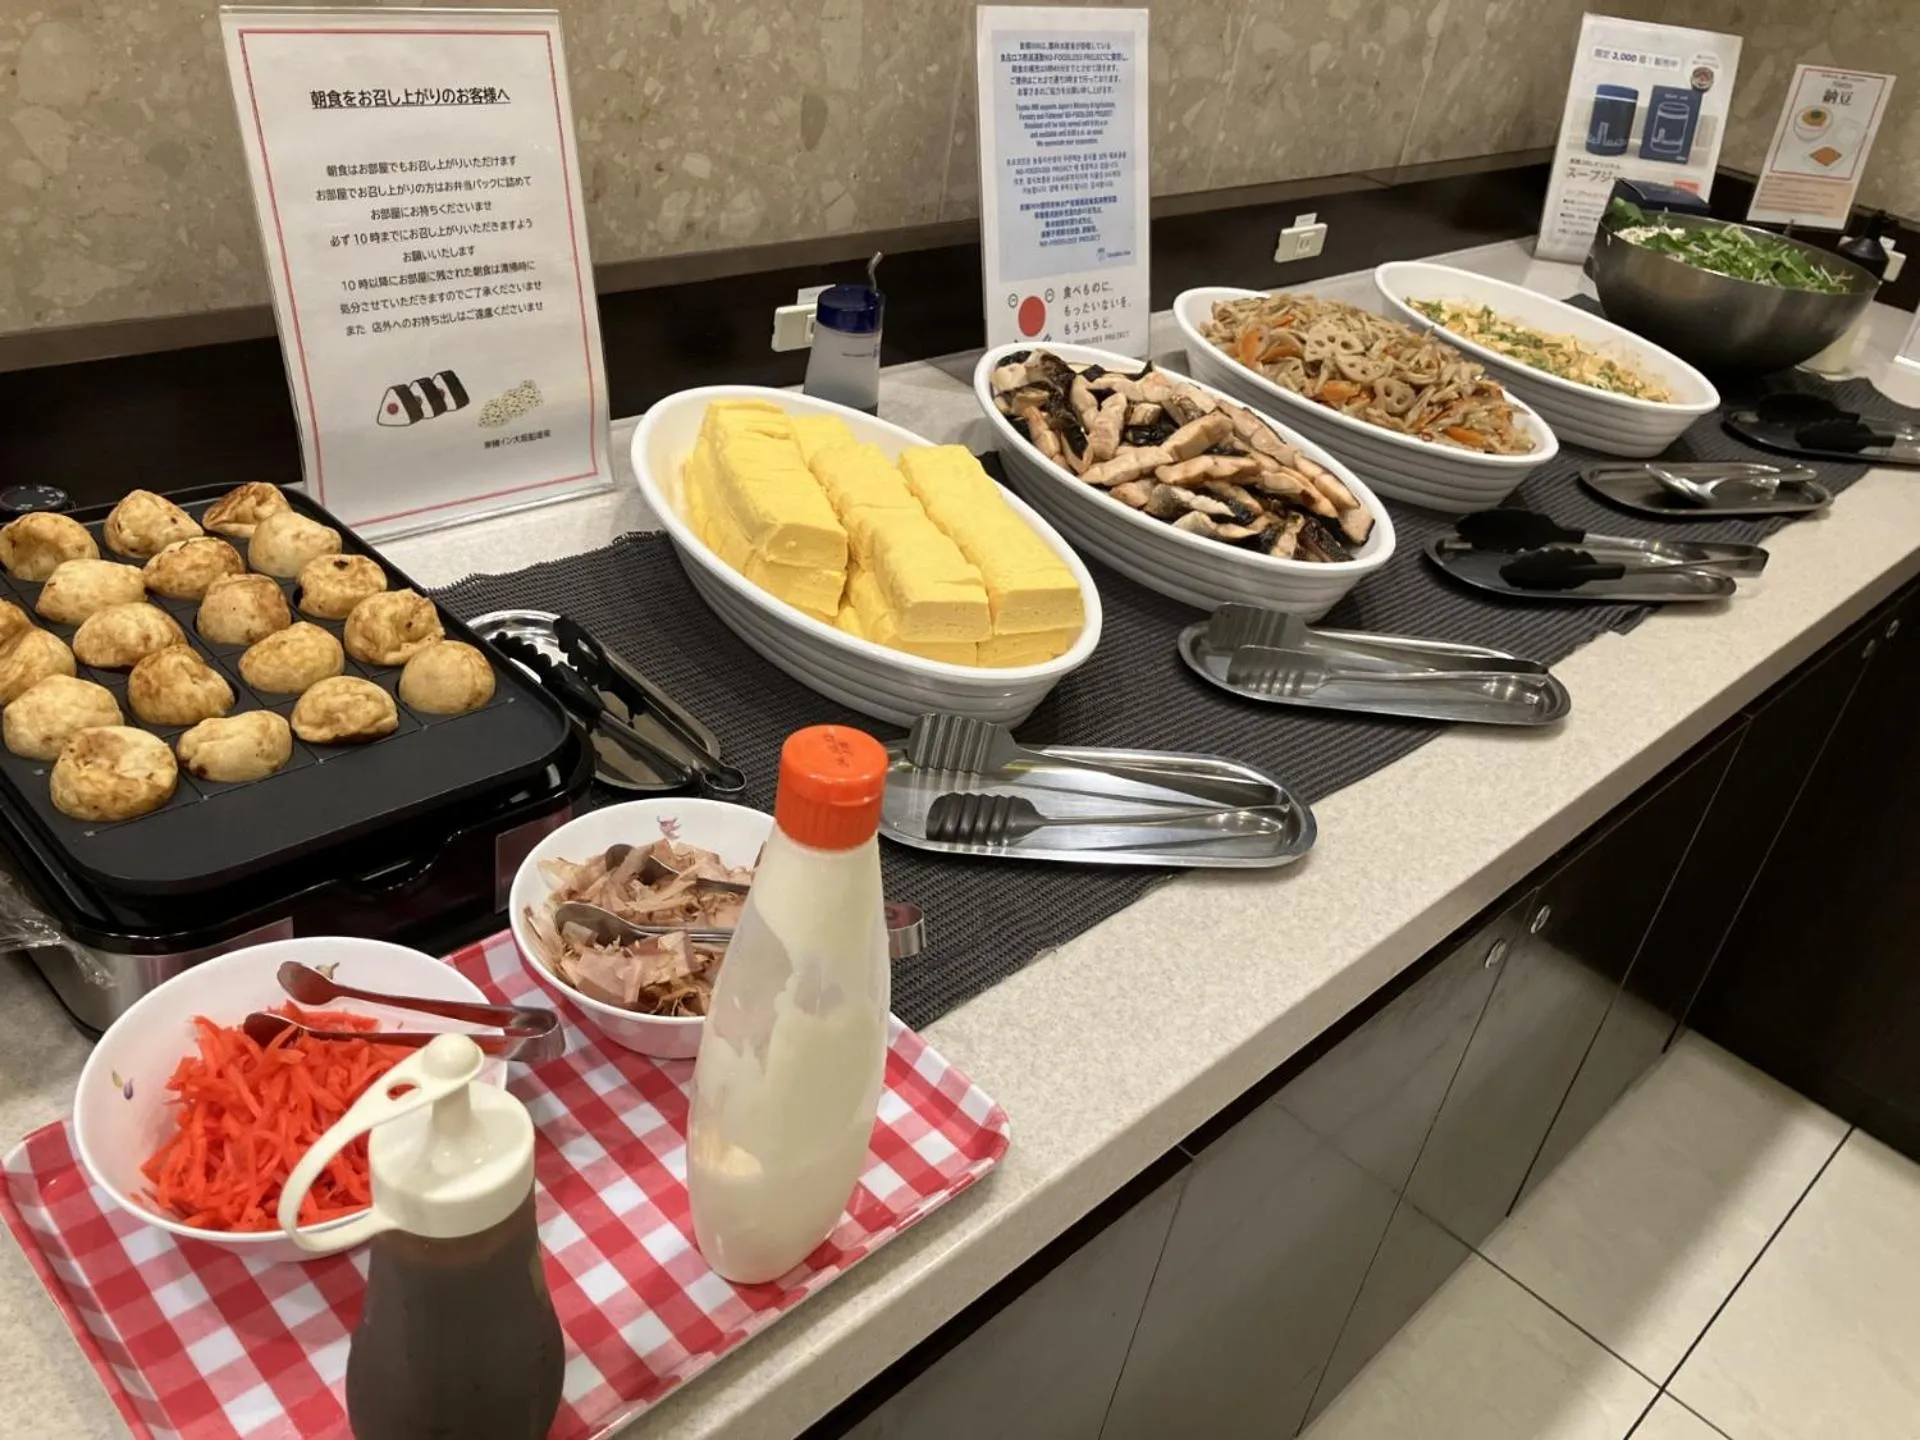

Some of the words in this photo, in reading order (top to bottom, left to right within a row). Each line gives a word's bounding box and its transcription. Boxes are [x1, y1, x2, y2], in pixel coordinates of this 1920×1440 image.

[310, 86, 511, 108] 朝食をお召し上がりのお客様へ
[326, 155, 517, 177] 朝食はお部屋でもお召し上がりいただけます
[315, 176, 532, 201] お部屋でお召し上がりの方はお弁当パックに詰めて
[371, 201, 492, 220] お部屋にお持ちくださいませ
[403, 245, 475, 263] お願いいたします
[345, 323, 366, 337] また
